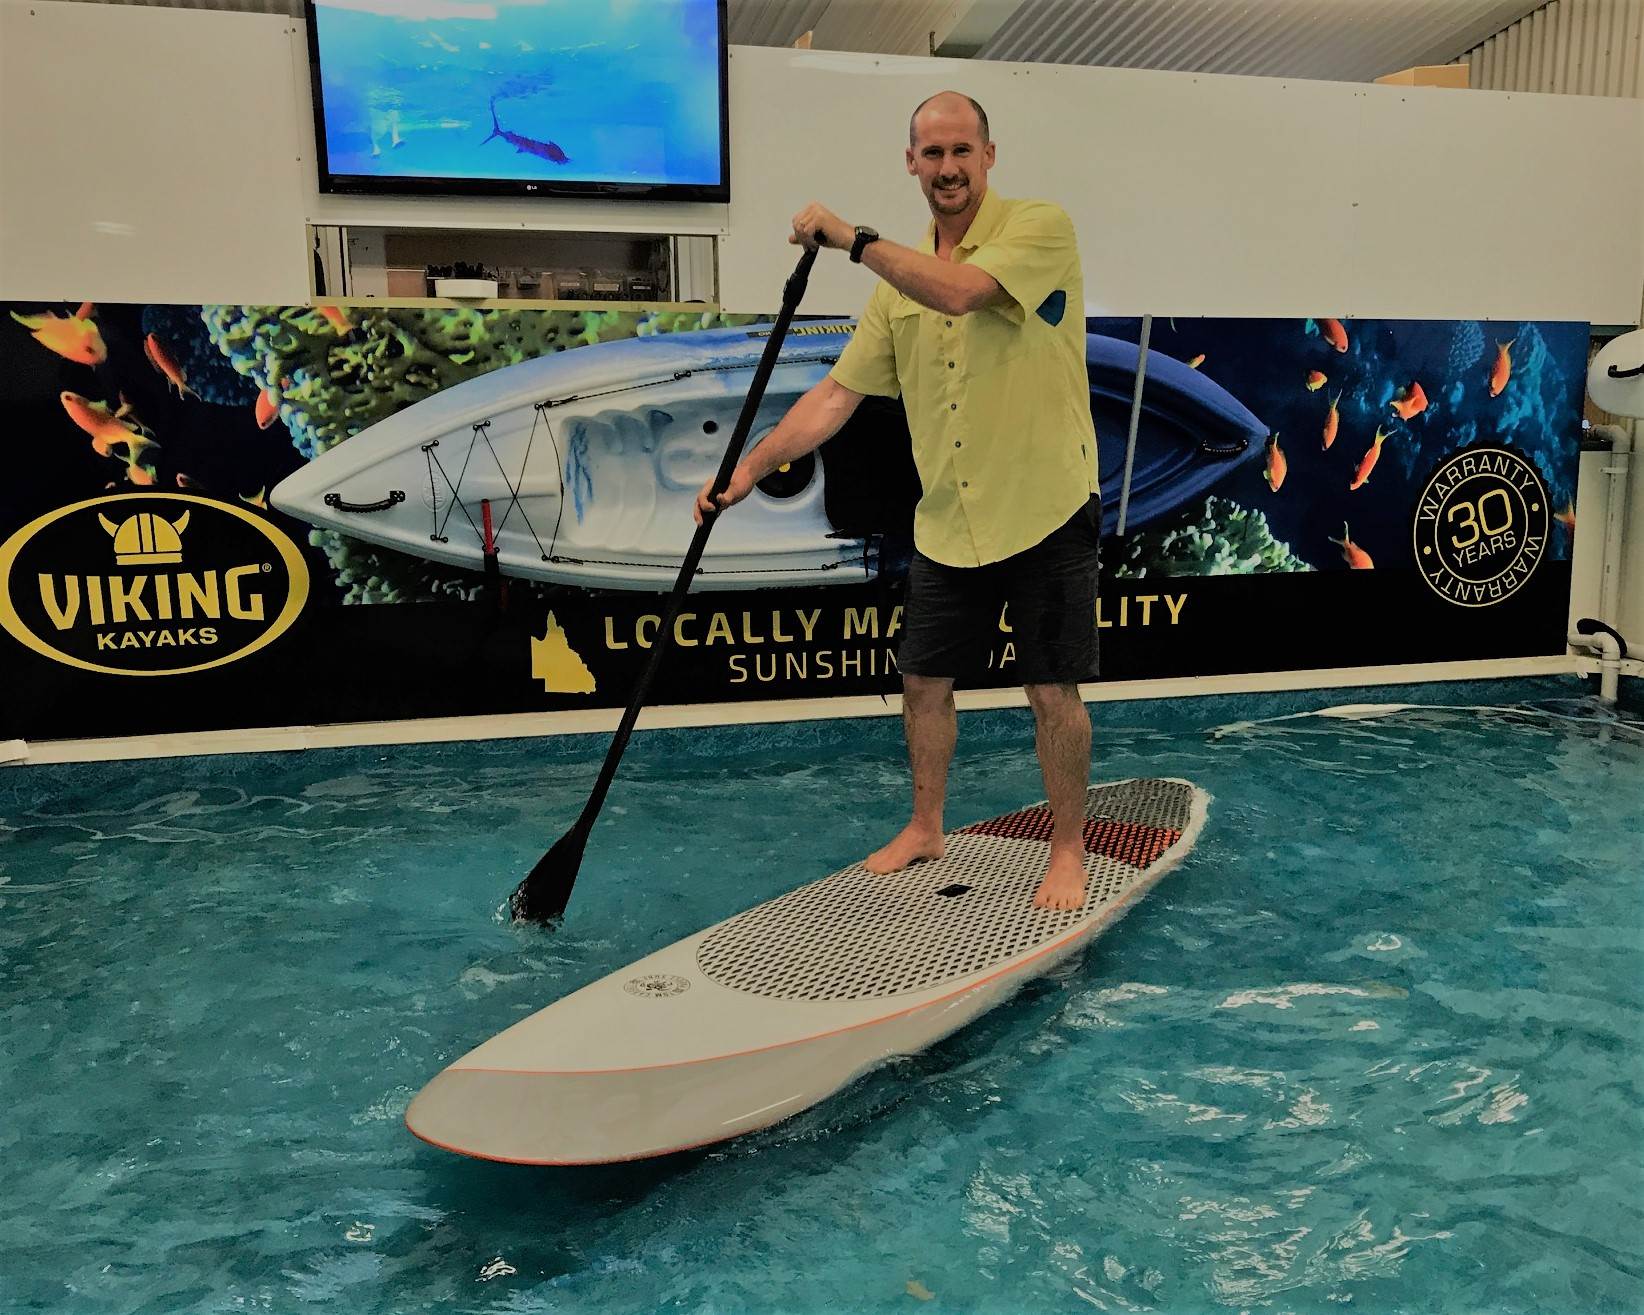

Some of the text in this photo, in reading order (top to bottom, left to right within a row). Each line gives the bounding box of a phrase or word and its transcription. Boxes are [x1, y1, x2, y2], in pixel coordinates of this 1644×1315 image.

[1420, 455, 1534, 520] WARRANTY
[1448, 489, 1513, 549] 30
[1430, 536, 1543, 601] WARRANTY
[1453, 530, 1516, 567] YEARS
[38, 563, 265, 631] VIKING
[97, 627, 219, 650] KAYAKS
[604, 608, 822, 649] LOCALLY
[843, 605, 905, 639] MA
[729, 647, 904, 683] SUNSHIN
